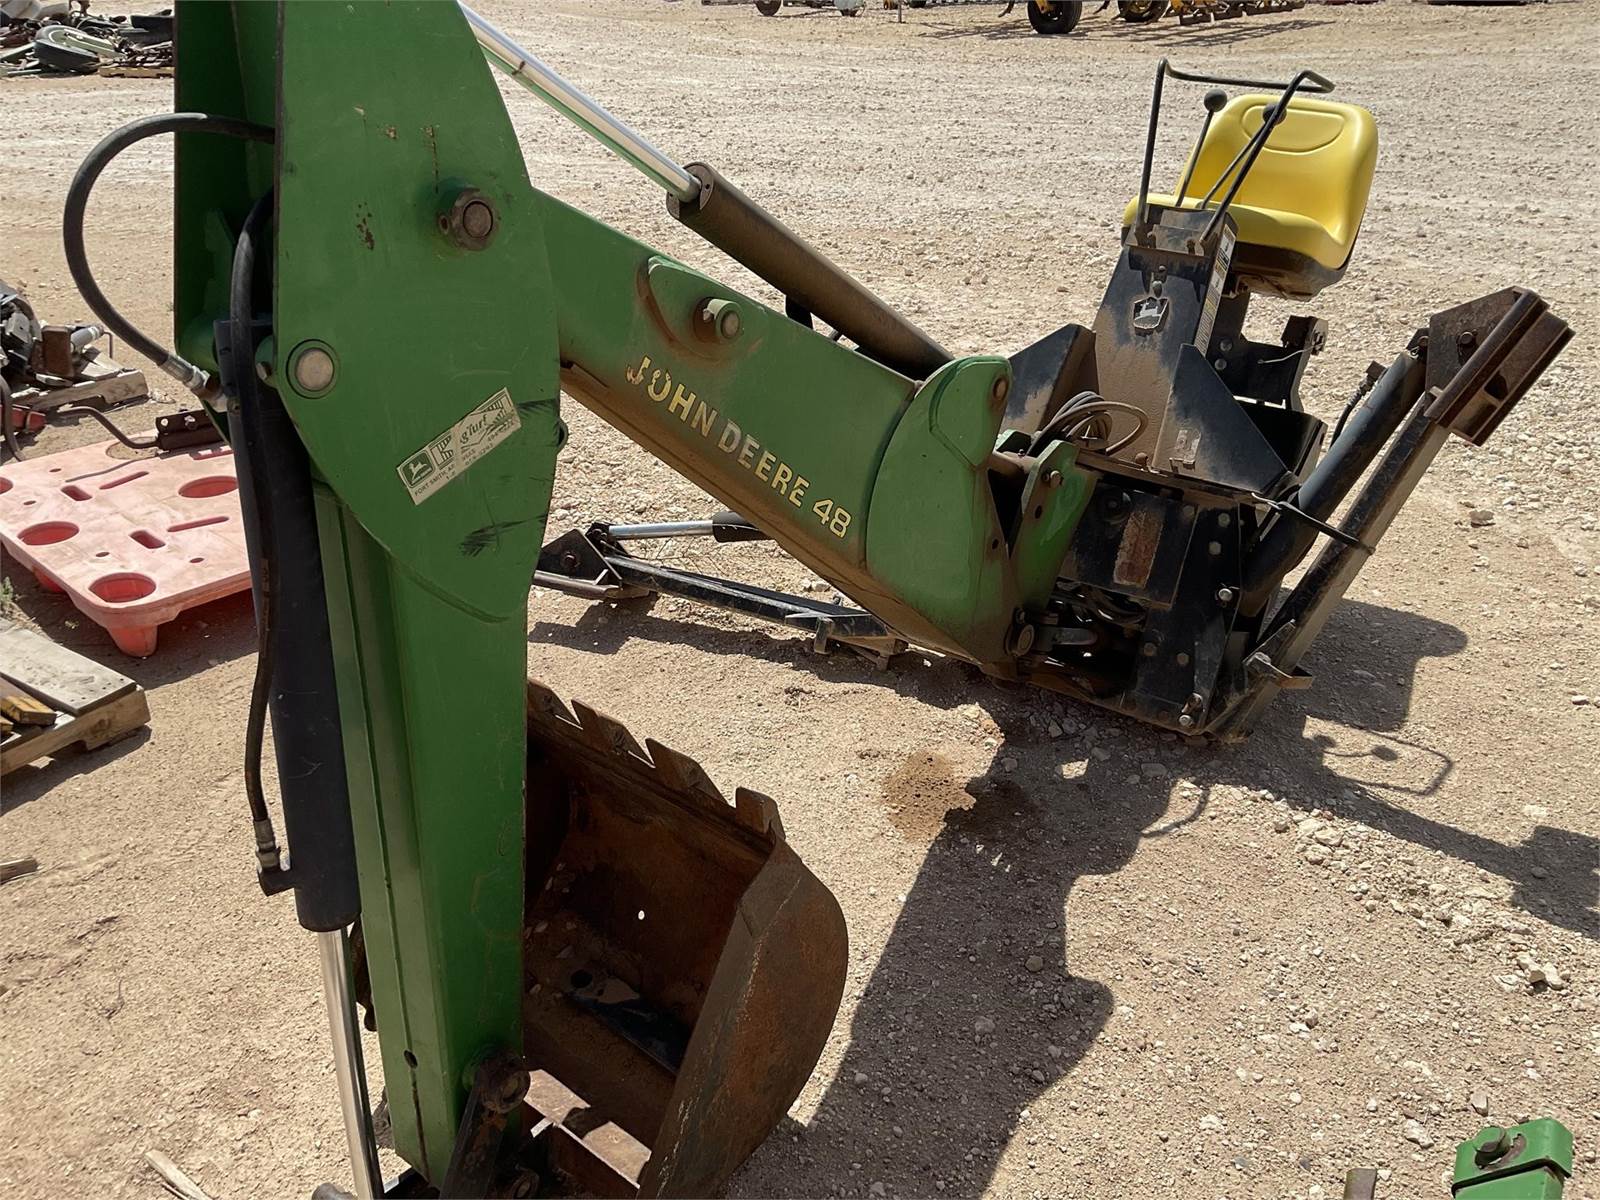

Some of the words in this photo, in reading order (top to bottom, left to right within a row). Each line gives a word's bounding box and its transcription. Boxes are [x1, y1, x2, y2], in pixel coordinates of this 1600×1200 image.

[414, 482, 430, 497] FORT
[626, 355, 718, 438] JOHN
[717, 419, 811, 508] DEERE
[812, 497, 852, 539] 48
